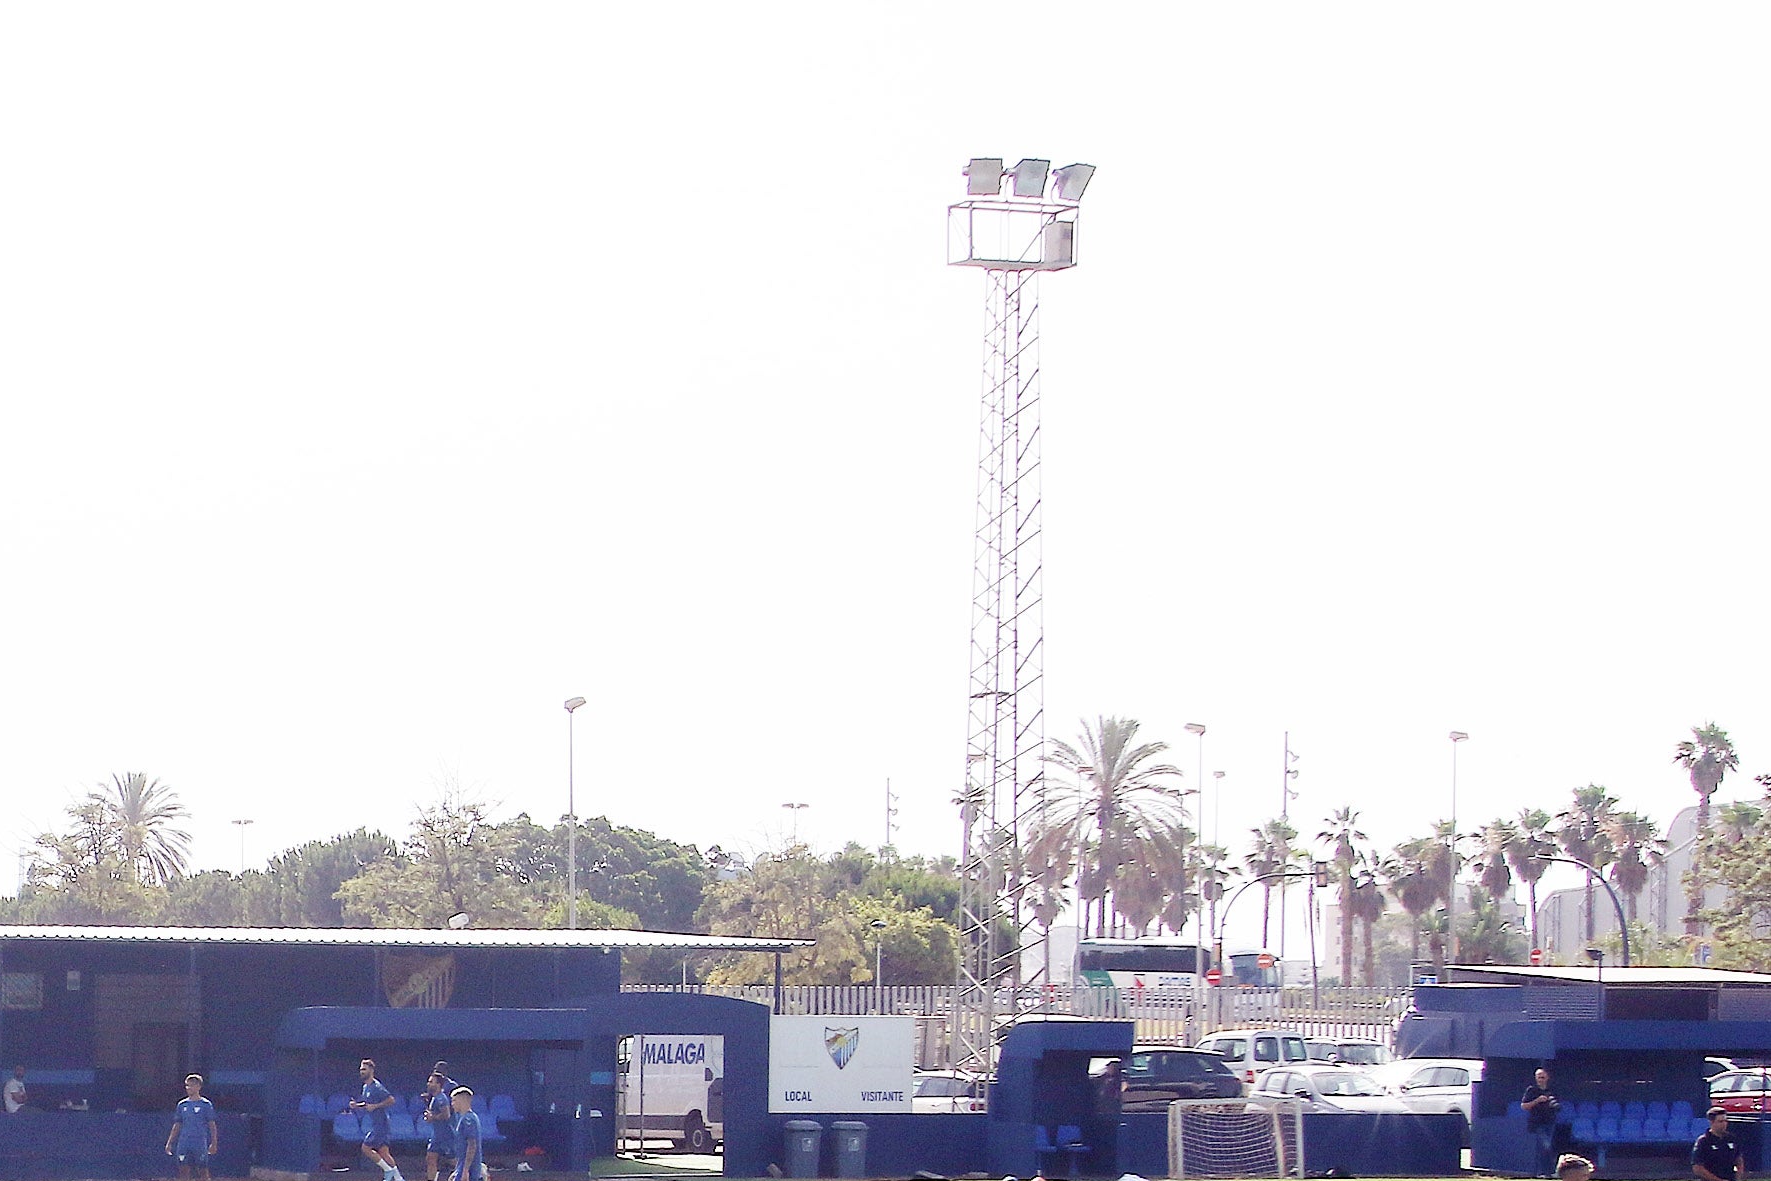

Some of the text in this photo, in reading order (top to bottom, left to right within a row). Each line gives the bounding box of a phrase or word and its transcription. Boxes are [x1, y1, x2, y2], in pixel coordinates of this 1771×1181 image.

[641, 1043, 705, 1064] MALAGA
[785, 1091, 813, 1102] LOCAL
[861, 1091, 904, 1102] VISITANTE
